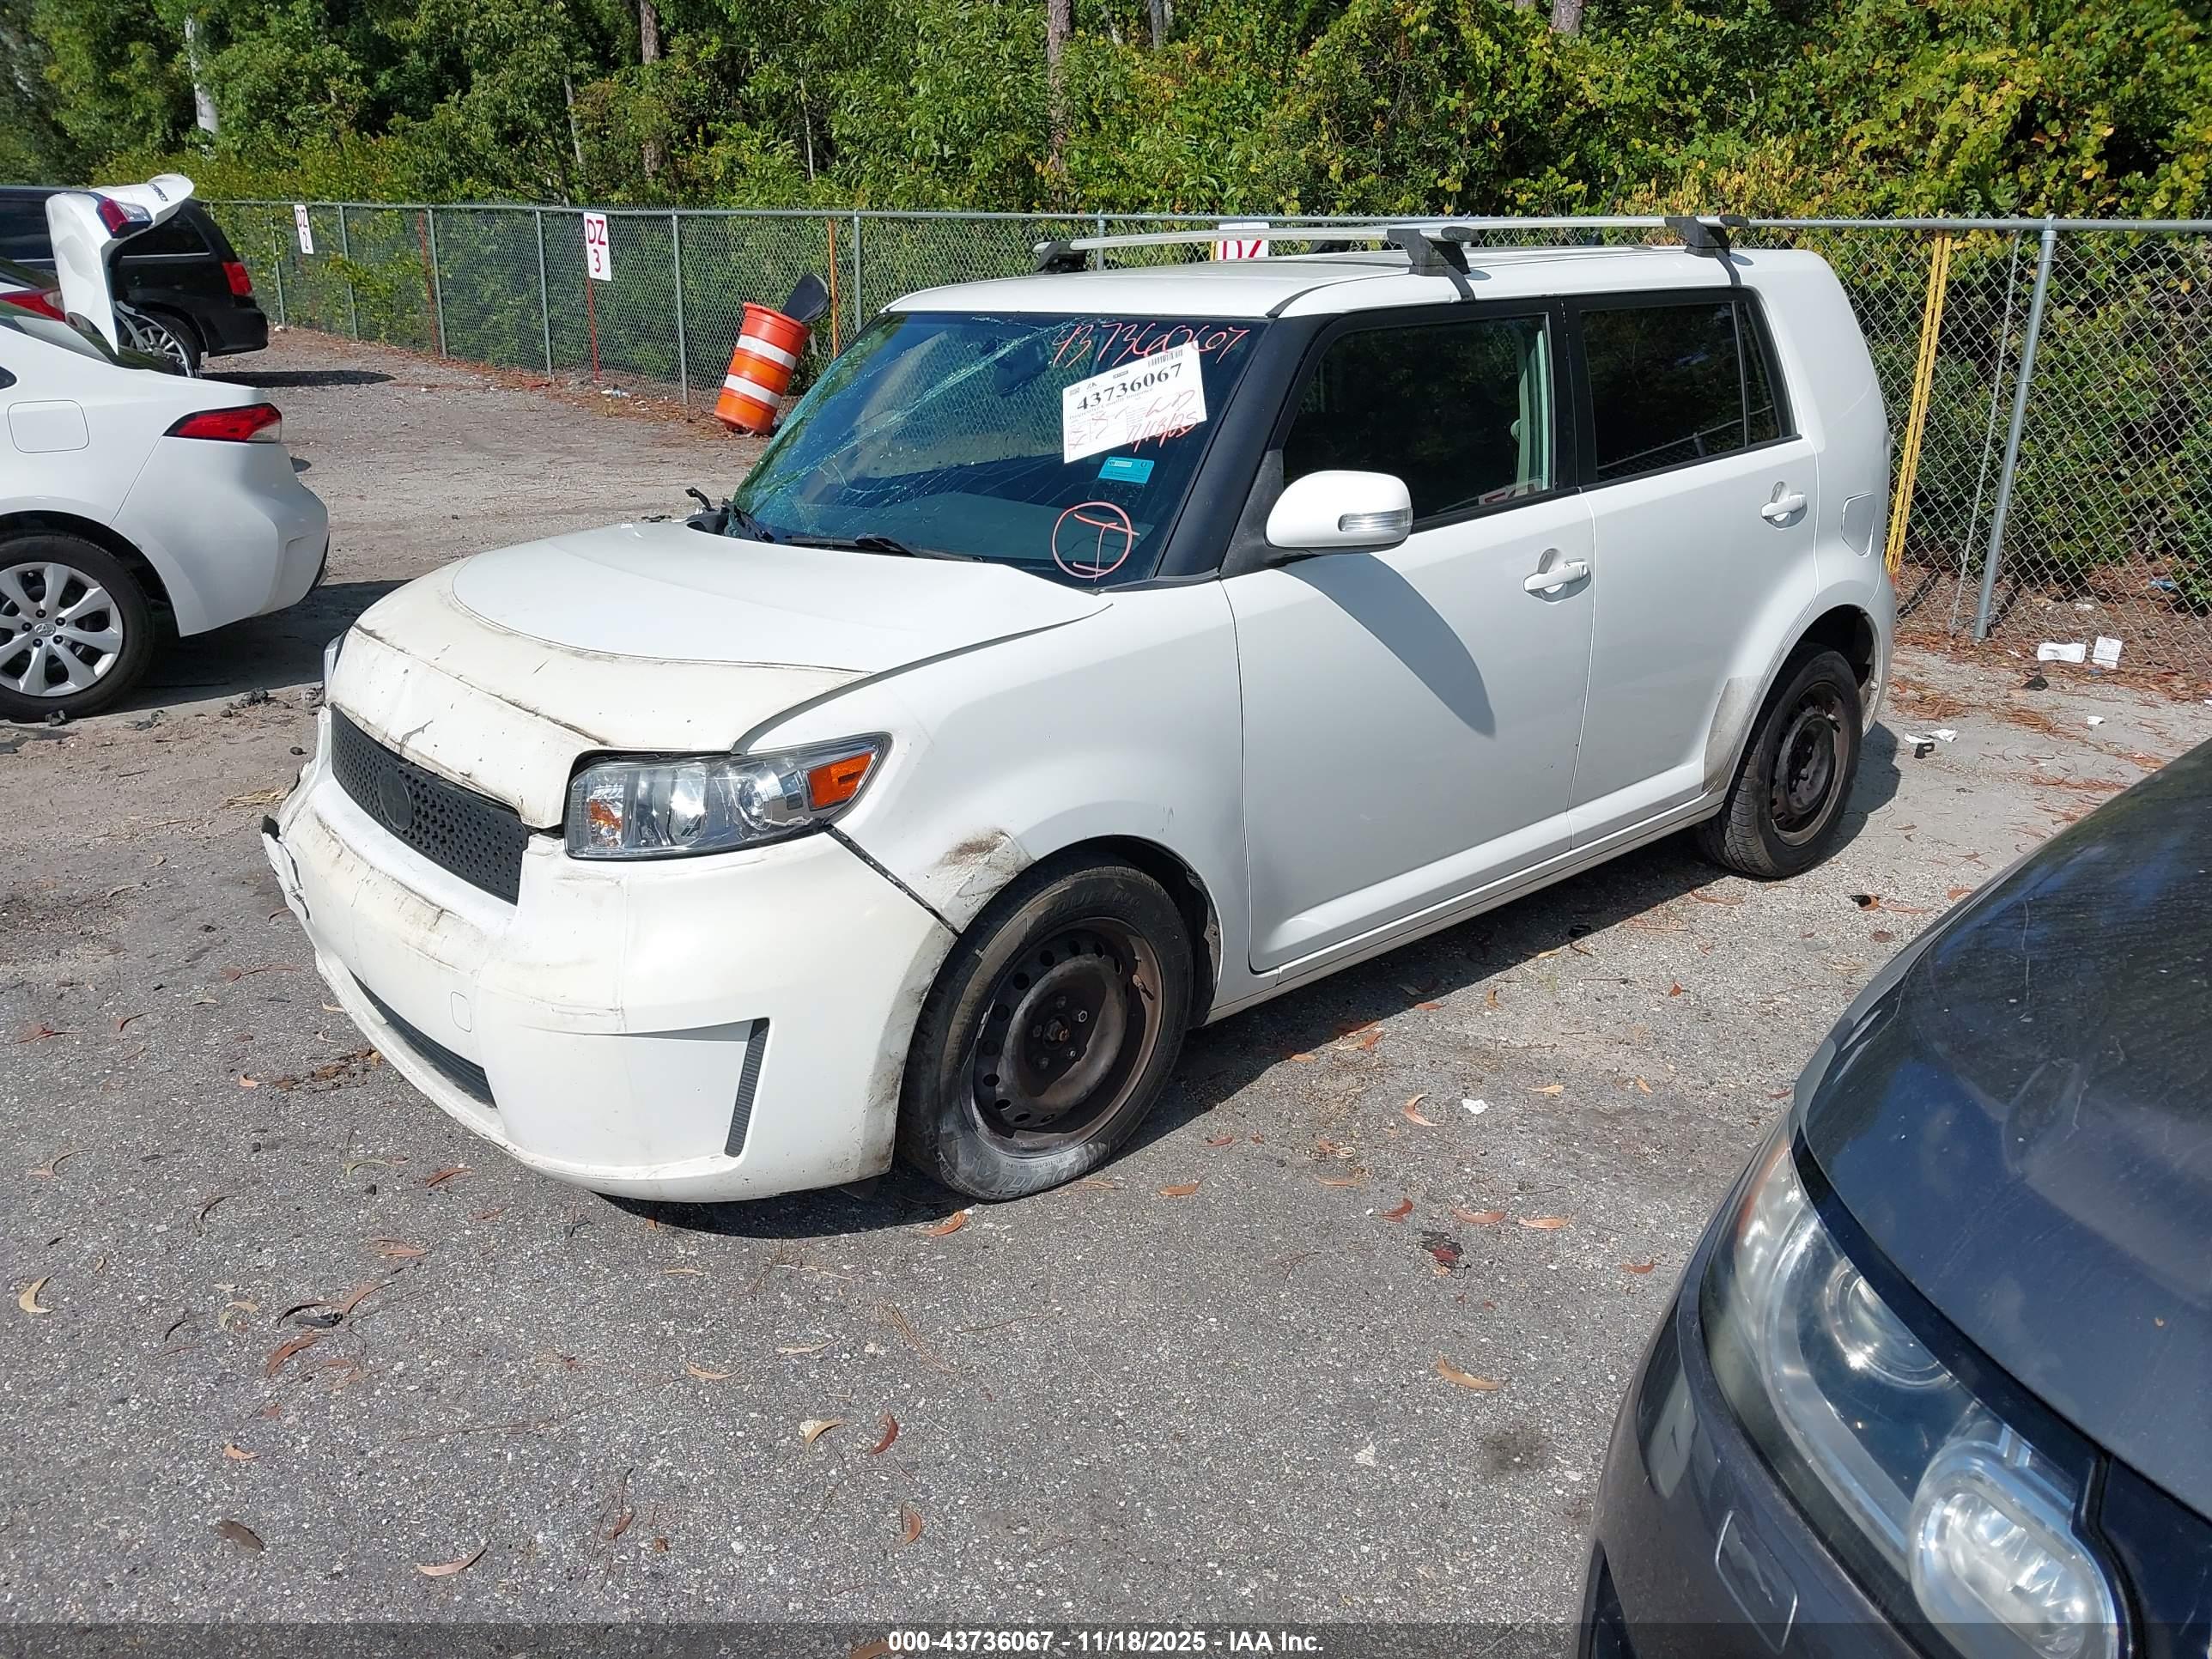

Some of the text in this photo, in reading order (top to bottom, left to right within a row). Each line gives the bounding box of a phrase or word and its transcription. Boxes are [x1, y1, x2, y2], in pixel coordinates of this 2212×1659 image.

[296, 209, 308, 228] DZ
[303, 231, 309, 249] 2
[586, 218, 606, 246] DZ
[593, 248, 601, 273] 3
[1077, 362, 1182, 410] 43736067
